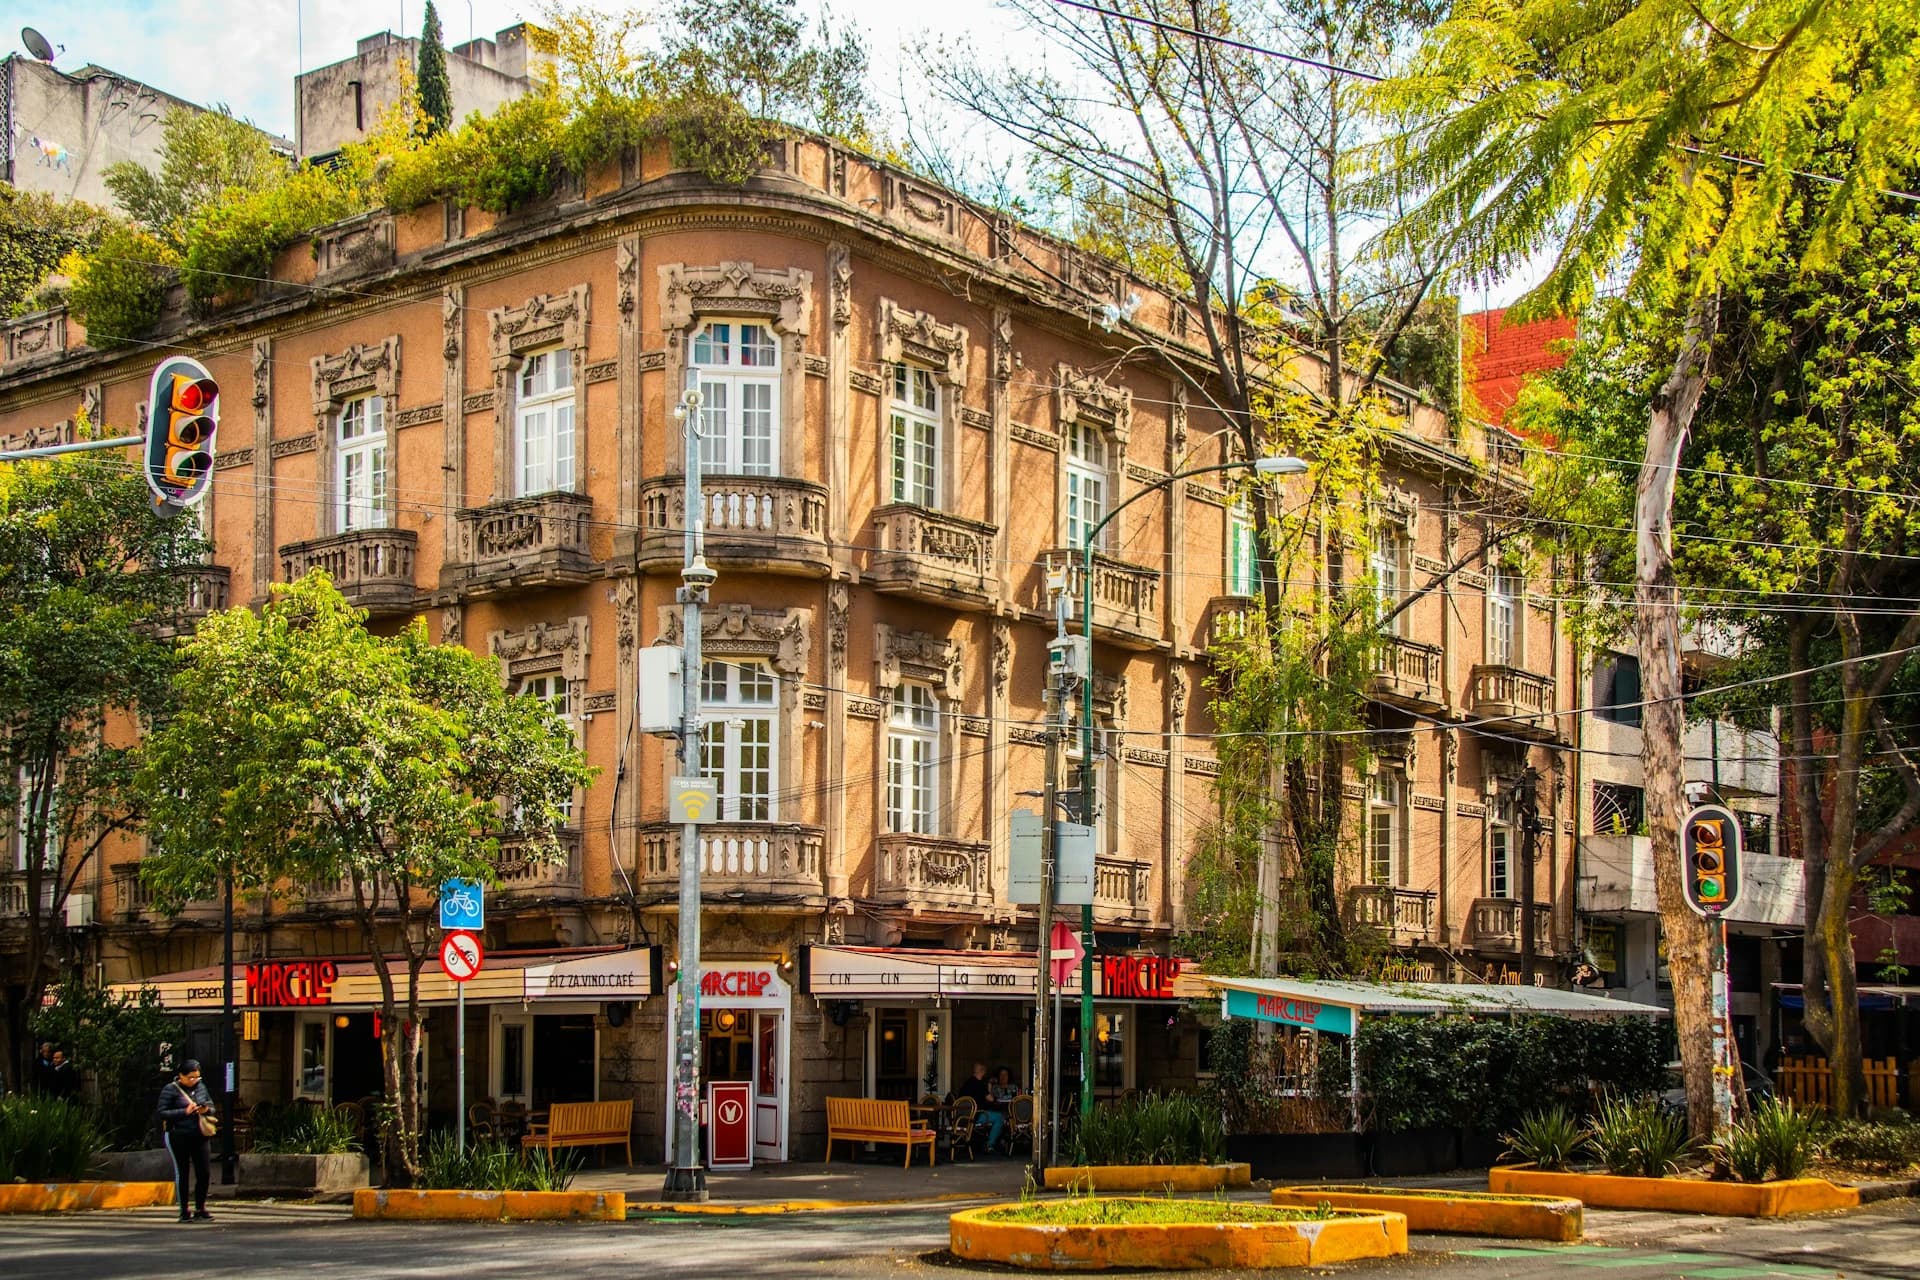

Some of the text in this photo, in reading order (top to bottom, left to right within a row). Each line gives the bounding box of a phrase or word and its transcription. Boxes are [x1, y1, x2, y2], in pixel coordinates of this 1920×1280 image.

[246, 961, 338, 1006] MARCELLO
[701, 971, 771, 997] ARCELLO
[829, 973, 900, 985] CIN CIN
[954, 969, 969, 985] La
[986, 973, 1016, 986] roma
[1102, 956, 1180, 998] MARCELLO
[187, 987, 226, 1003] presen
[1256, 993, 1322, 1024] MARCELLO
